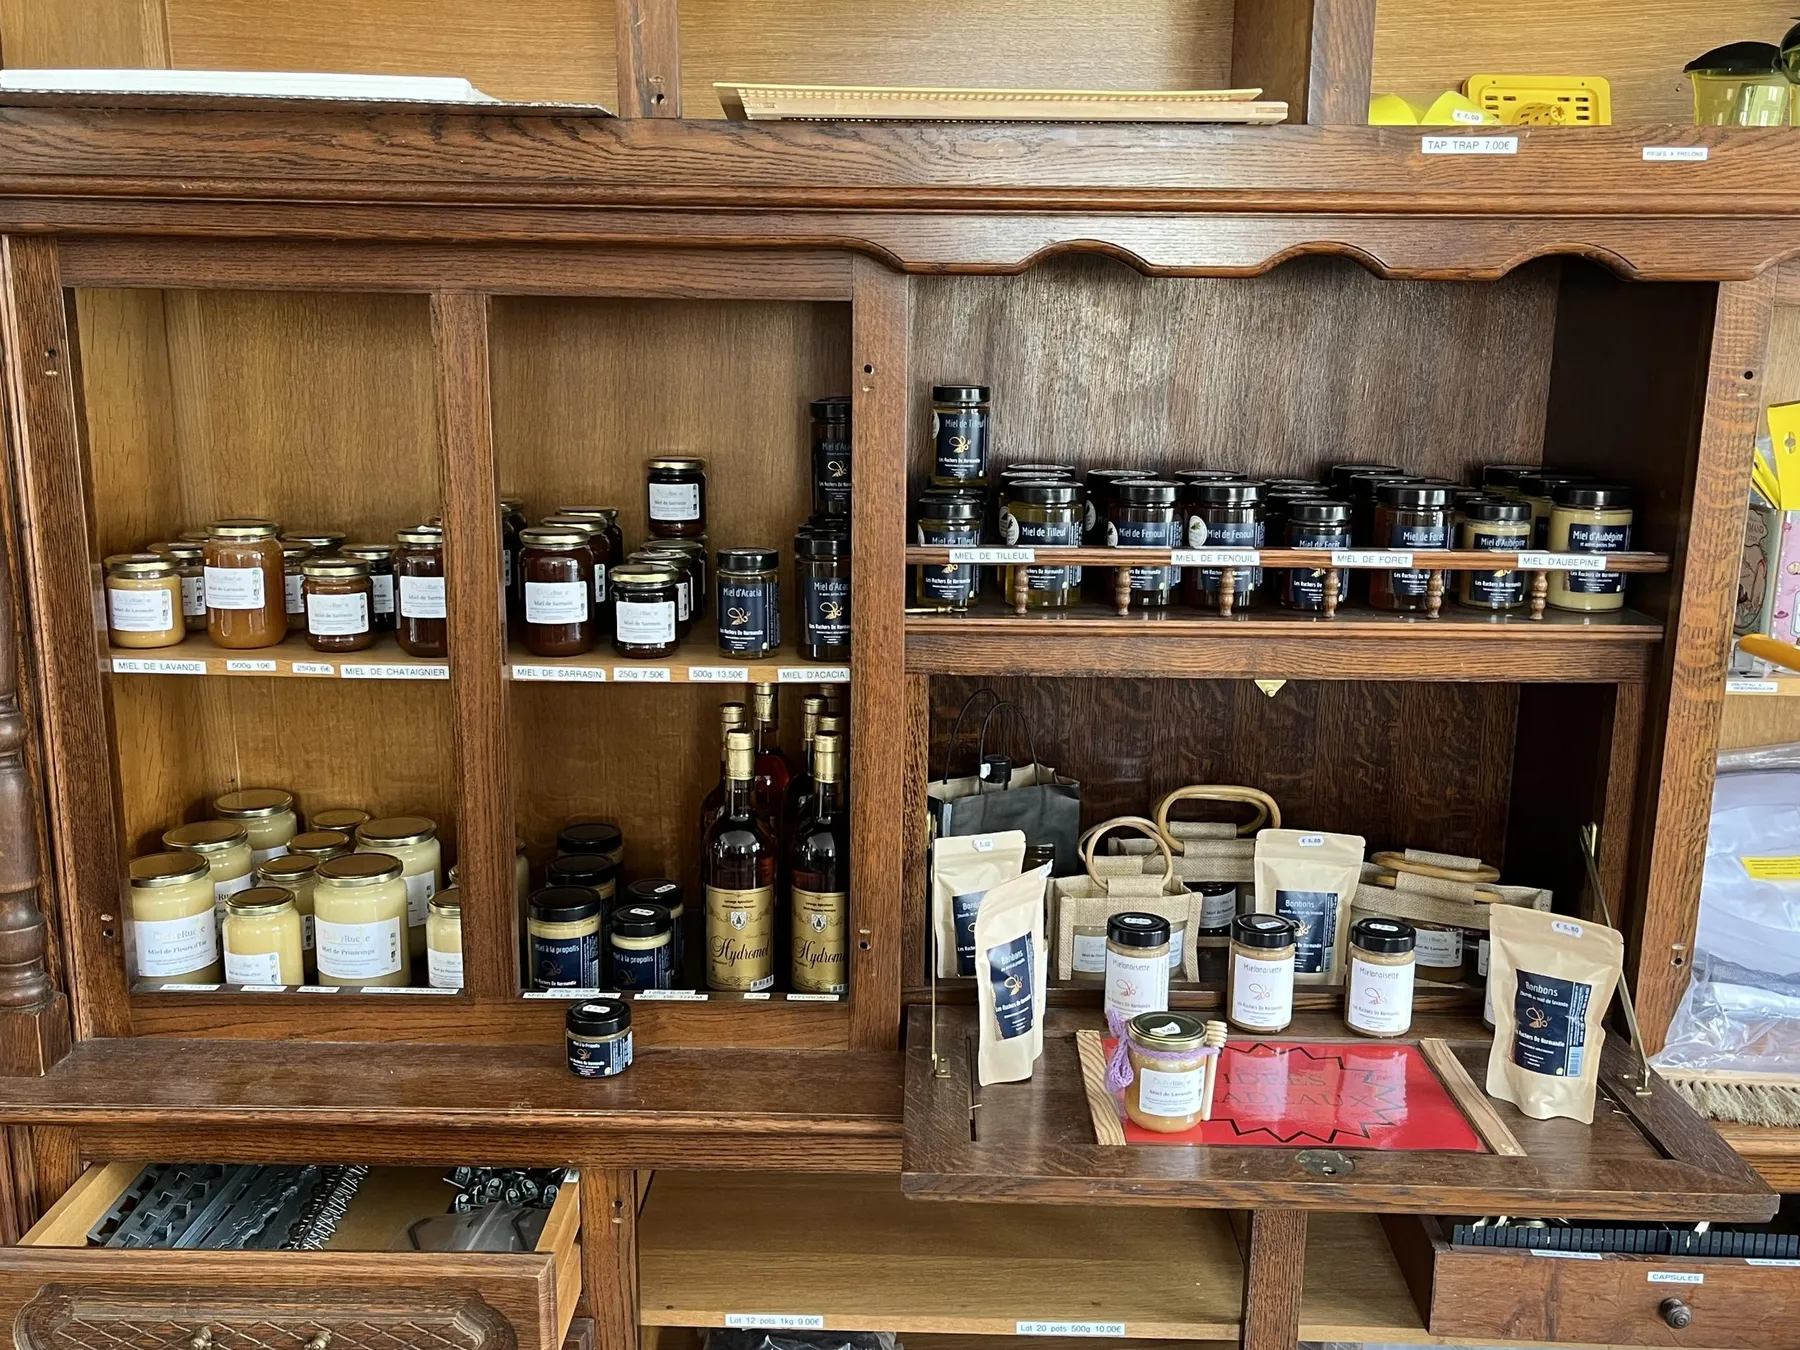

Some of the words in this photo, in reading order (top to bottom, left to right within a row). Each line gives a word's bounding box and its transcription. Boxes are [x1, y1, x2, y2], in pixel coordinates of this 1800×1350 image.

[1428, 141, 1447, 149] TAP
[1453, 141, 1479, 150] TRAP
[1485, 141, 1510, 150] 7.00€
[945, 419, 958, 427] Miel
[1022, 527, 1035, 536] Miel
[1036, 527, 1045, 537] de
[1047, 527, 1066, 537] Tilleul
[1119, 528, 1131, 537] Miel
[1132, 528, 1140, 537] de
[1142, 528, 1165, 538] Fenouil
[1207, 529, 1221, 538] Miel
[1222, 529, 1231, 539] de
[1232, 529, 1254, 539] Fenouil
[1403, 531, 1418, 541] Miel
[1420, 532, 1427, 541] de
[1573, 530, 1587, 540] Miel
[1589, 530, 1624, 542] d'Aubépine
[1481, 537, 1495, 547] Miel
[996, 552, 1029, 560] TILLEUL
[1337, 555, 1357, 563] MIEL
[1379, 556, 1409, 564] FORET
[1523, 557, 1544, 565] MIEL
[1548, 558, 1599, 567] D'AUBEPINE
[723, 588, 735, 597] Miel
[736, 588, 762, 597] d'Acacia
[118, 662, 139, 670] MIEL
[144, 662, 156, 671] DE
[160, 663, 201, 671] LAVANDE
[320, 665, 330, 673] 6€
[386, 668, 445, 676] CHATAIGNIER
[542, 669, 553, 677] DE
[558, 670, 602, 678] SARRASIN
[618, 670, 638, 679] 250g
[693, 670, 712, 678] 500g
[782, 671, 802, 679] MIEL
[807, 671, 845, 679] D'ACACIA
[1285, 899, 1315, 908] Bonbons
[173, 944, 193, 953] Fleurs
[550, 944, 555, 953] la
[556, 944, 580, 955] propolis
[709, 935, 770, 967] Hydromel
[793, 937, 846, 969] Hydrom
[625, 953, 630, 963] la
[630, 954, 654, 964] propolis
[1001, 950, 1024, 965] Bonbons
[1525, 981, 1559, 997] Bonbons
[1540, 1037, 1565, 1048] Normandie
[1220, 1092, 1376, 1107] ADEAUX
[1652, 1274, 1700, 1282] CAPSULES
[1020, 1324, 1033, 1332] Lot
[1050, 1325, 1067, 1333] pots
[1071, 1325, 1091, 1333] 500g
[1096, 1325, 1121, 1333] 10.00€
